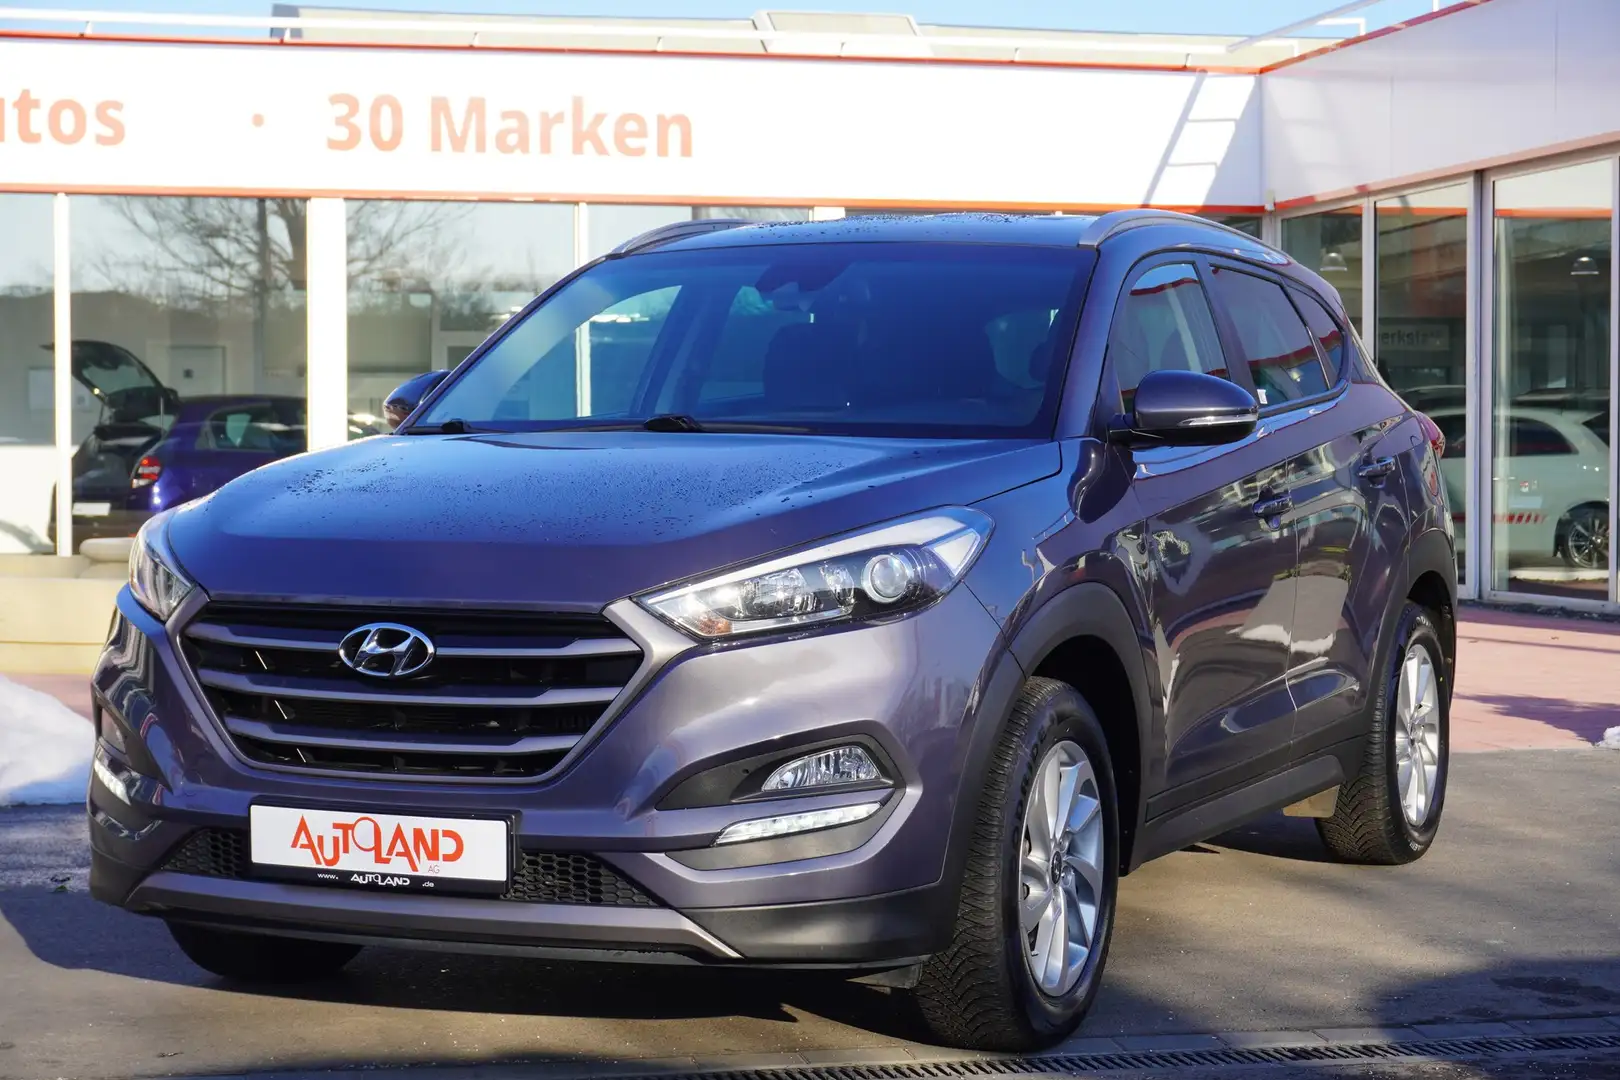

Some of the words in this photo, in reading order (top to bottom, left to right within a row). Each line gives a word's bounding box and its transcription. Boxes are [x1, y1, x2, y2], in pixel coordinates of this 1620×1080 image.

[0, 88, 126, 146] tos
[326, 92, 404, 152] 30
[430, 94, 694, 158] Marken
[291, 814, 465, 873] AUTOLAND
[317, 872, 340, 880] www.
[350, 873, 411, 887] AUTOLAND
[422, 880, 435, 888] .de
[427, 864, 441, 875] AG
